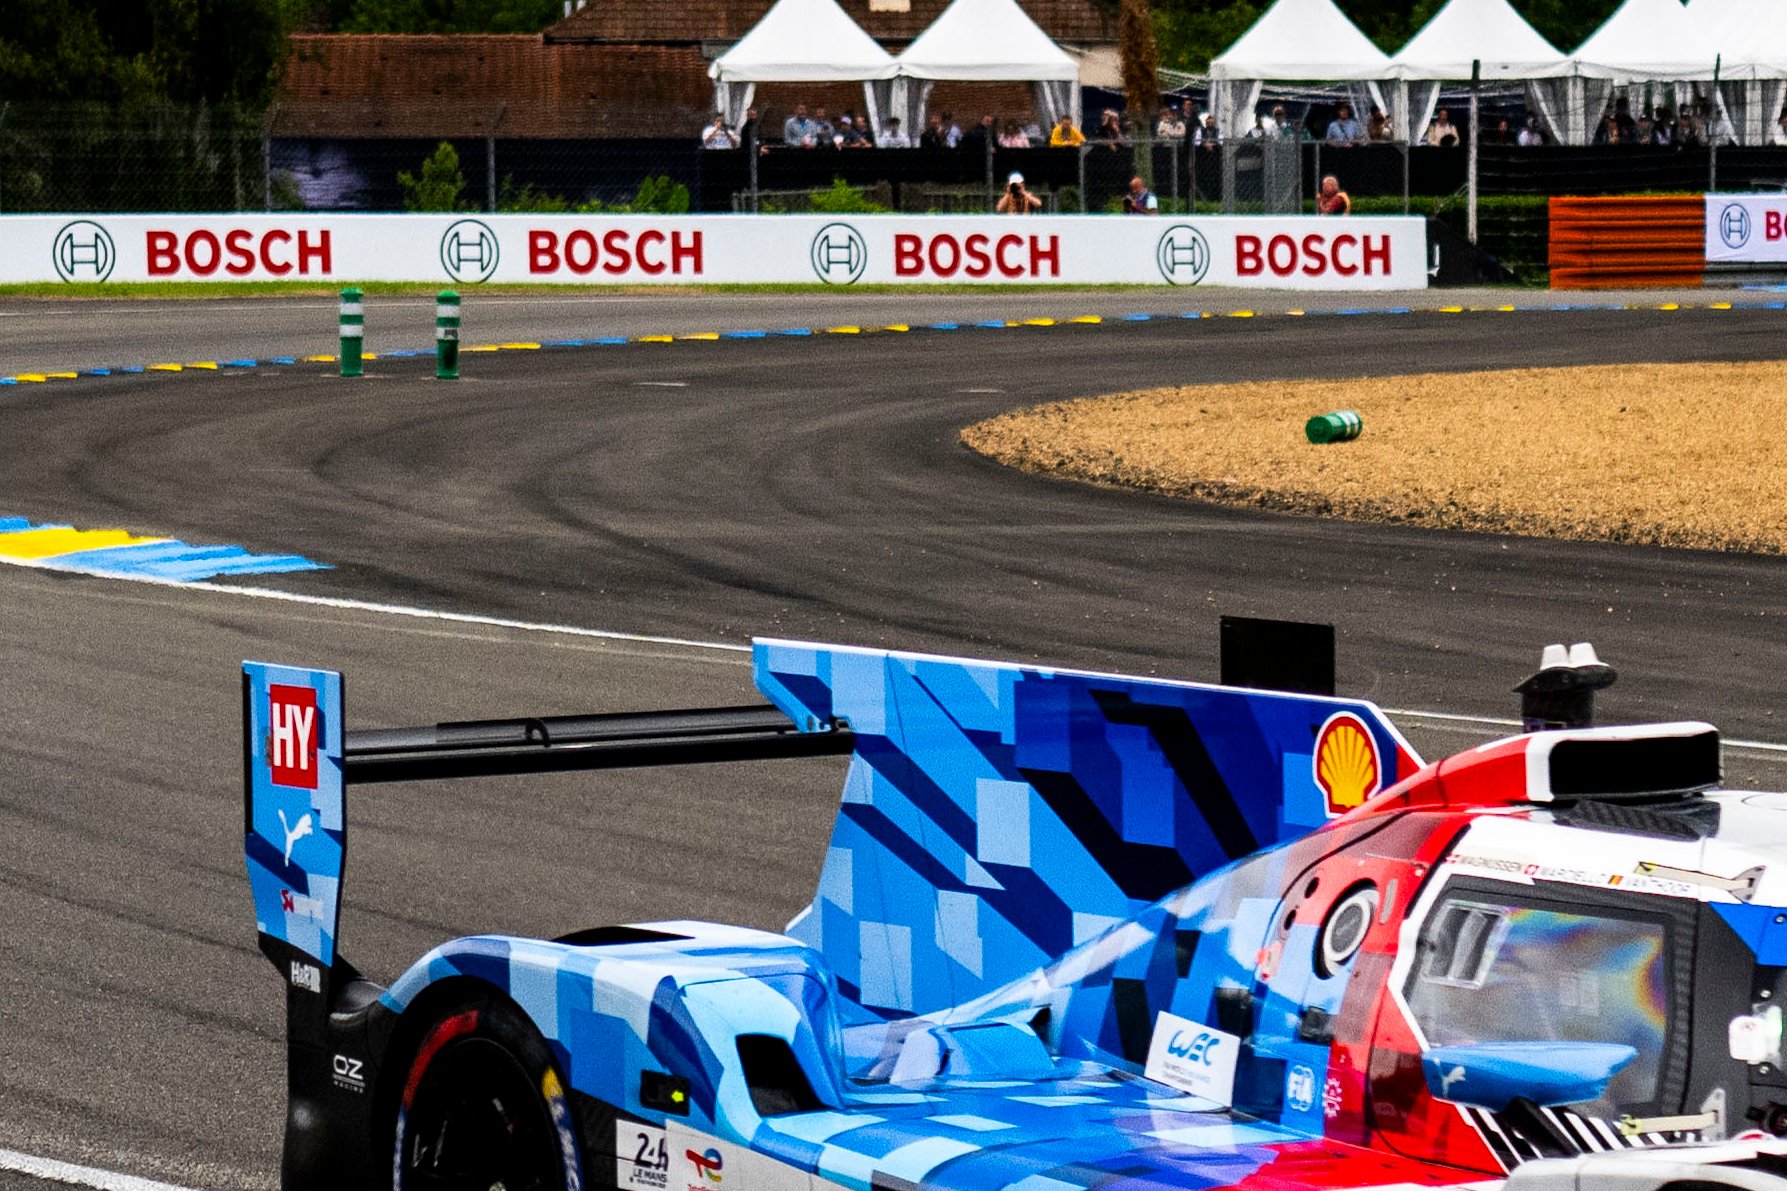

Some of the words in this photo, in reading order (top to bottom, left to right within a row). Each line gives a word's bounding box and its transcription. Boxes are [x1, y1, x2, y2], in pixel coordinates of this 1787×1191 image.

[145, 228, 332, 276] BOSCH
[527, 229, 703, 275] BOSCH
[894, 233, 1060, 278] BOSCH
[1235, 233, 1392, 277] BOSCH
[272, 702, 314, 771] HY
[333, 1054, 363, 1080] OZ
